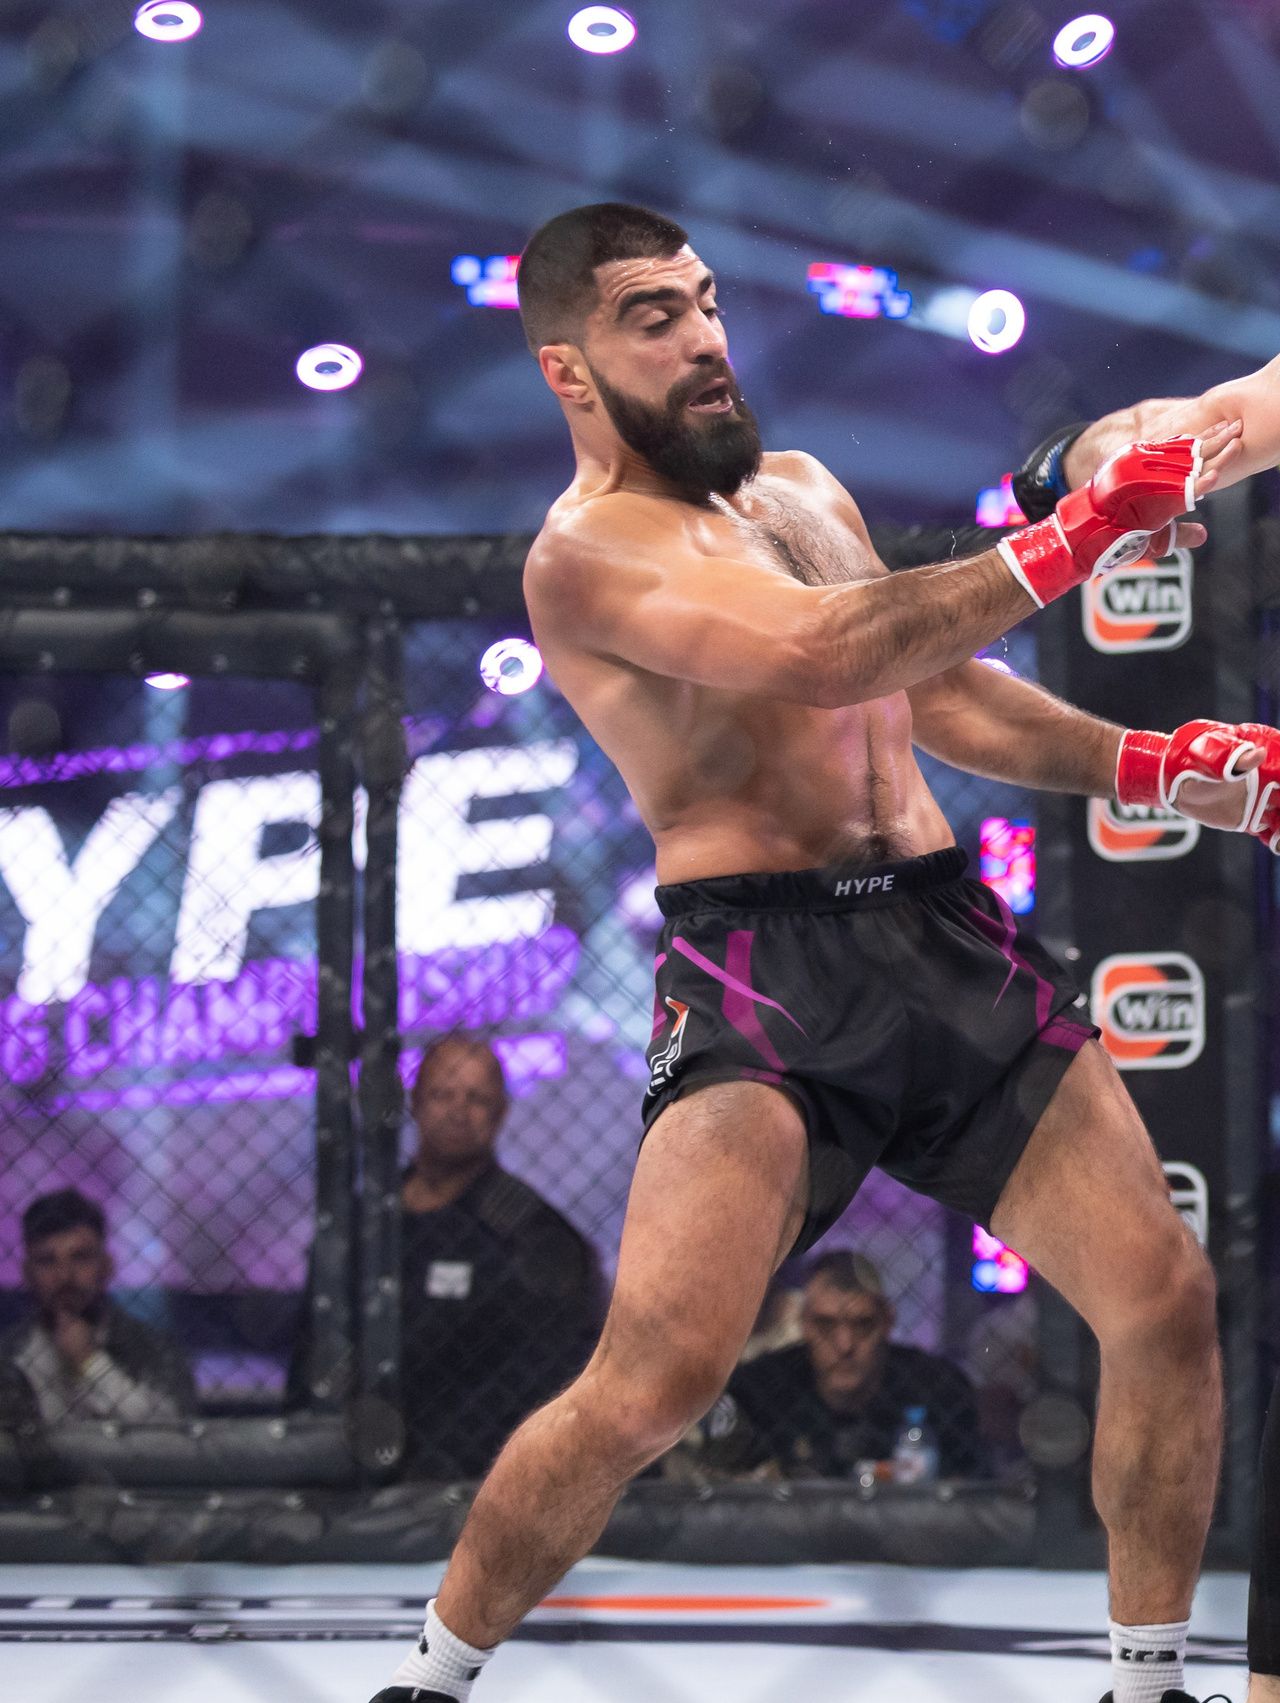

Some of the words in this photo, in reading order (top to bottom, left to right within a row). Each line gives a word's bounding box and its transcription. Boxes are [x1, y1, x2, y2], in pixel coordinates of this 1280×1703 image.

[1108, 579, 1183, 612] Win
[834, 874, 895, 897] HYPE
[1116, 992, 1195, 1029] Win
